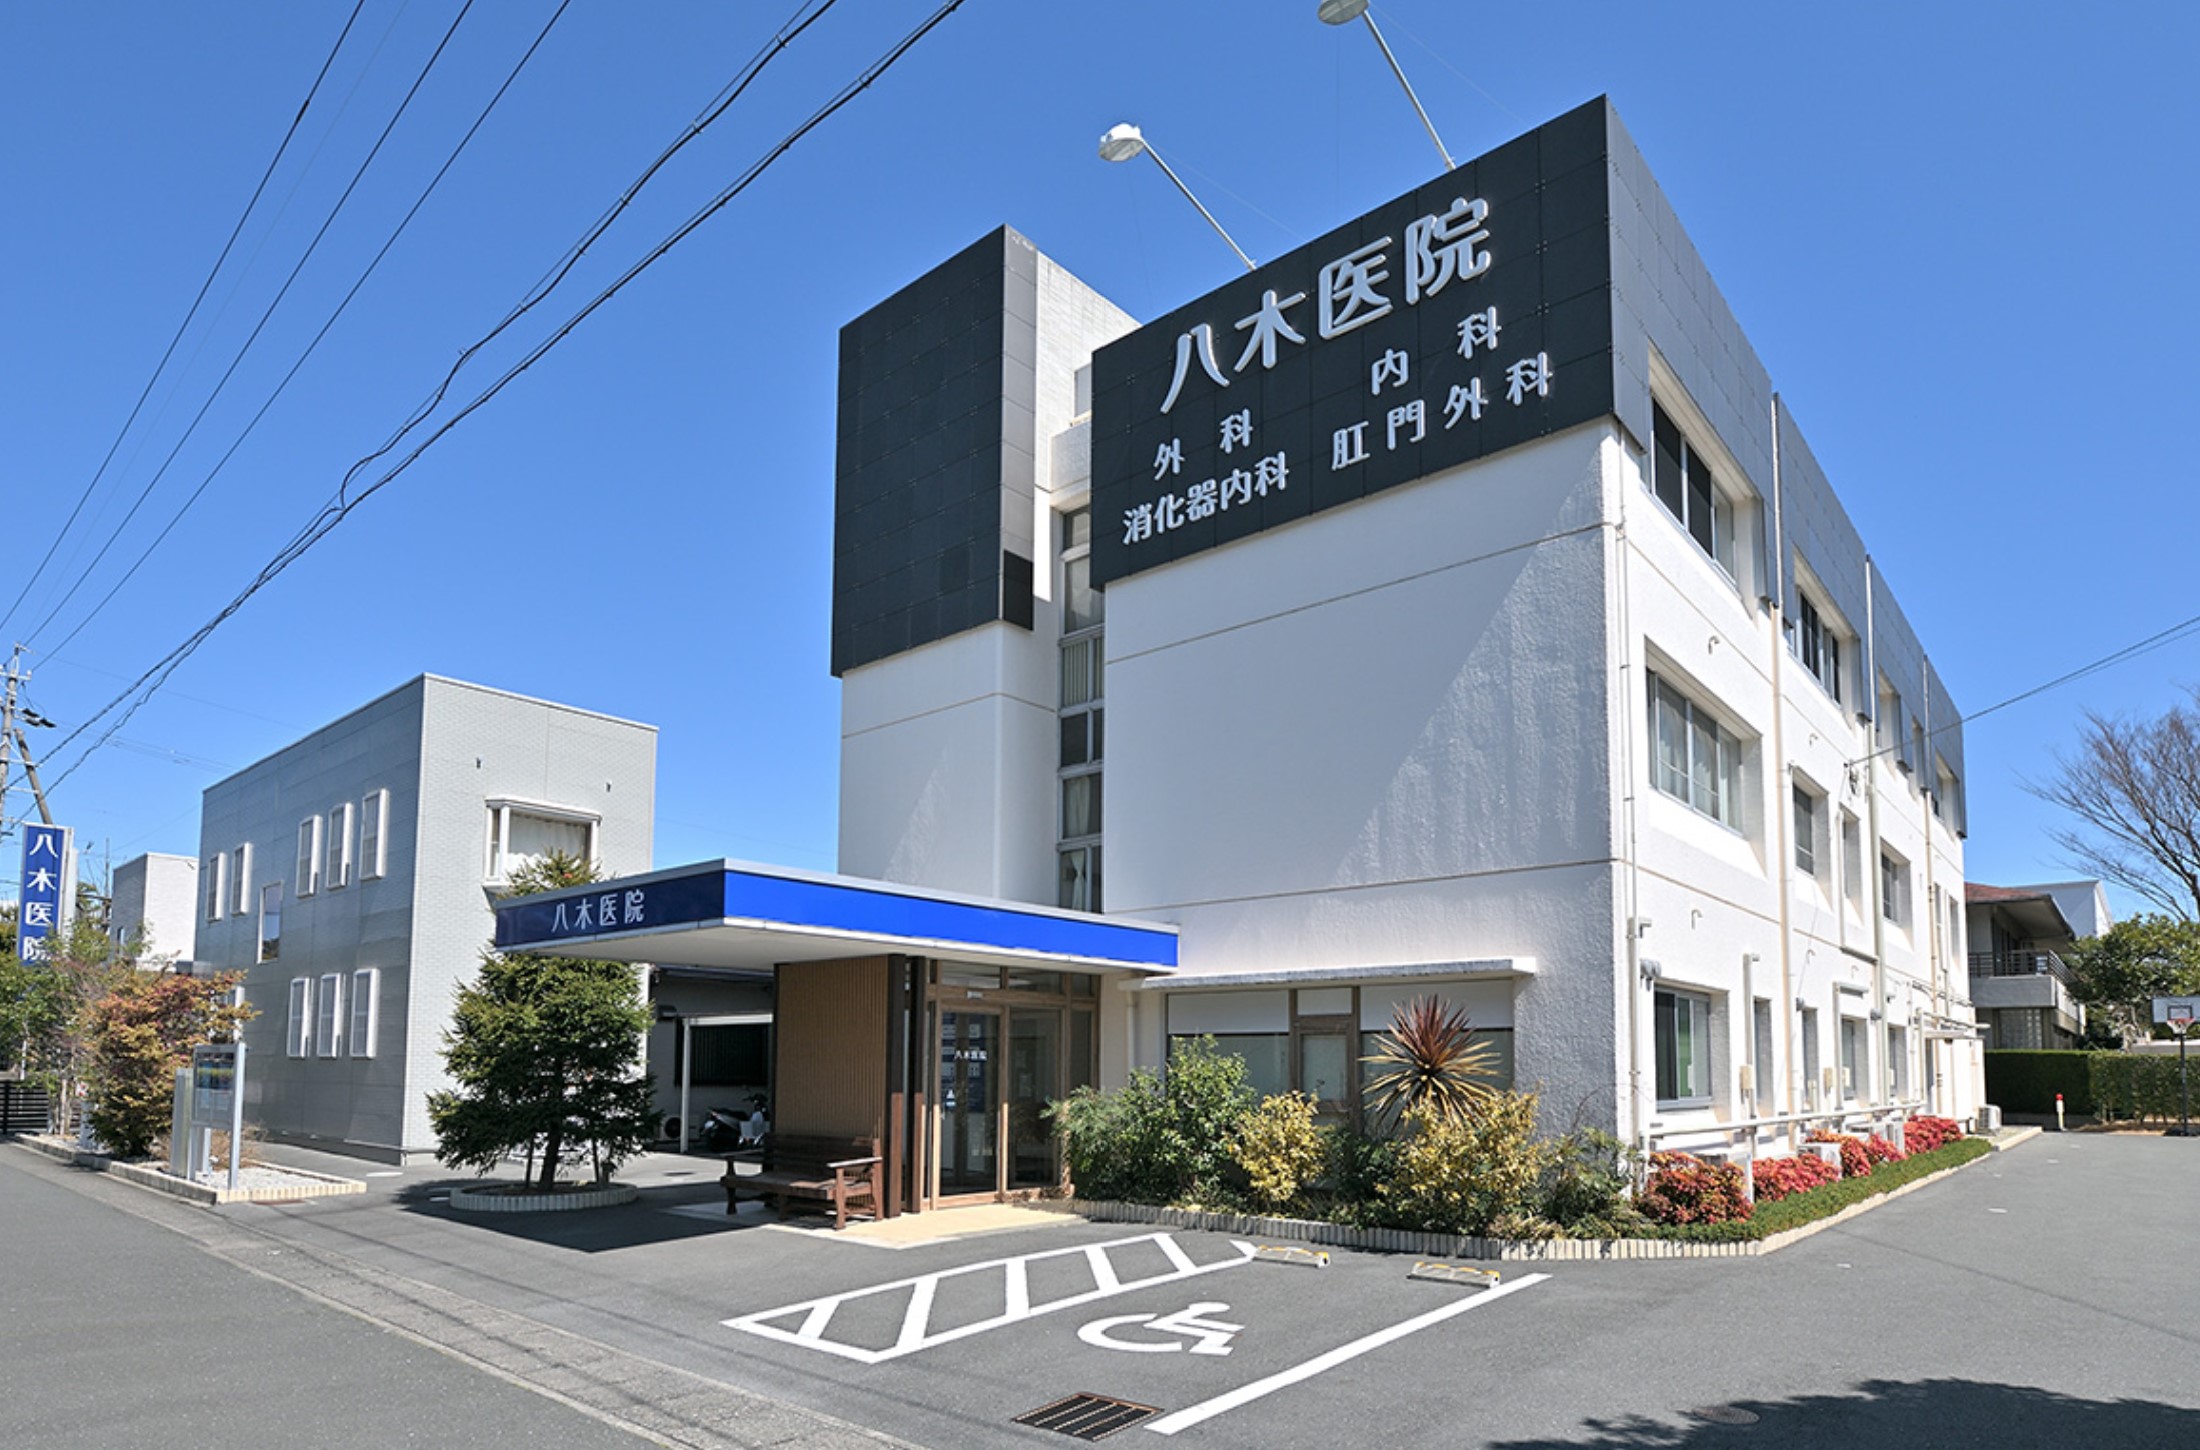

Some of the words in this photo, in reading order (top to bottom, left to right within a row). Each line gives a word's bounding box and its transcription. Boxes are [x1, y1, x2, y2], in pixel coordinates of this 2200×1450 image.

[1160, 197, 1492, 414] 八木医院
[1122, 451, 1290, 545] 消化器内科
[1331, 351, 1553, 471] 肛門外科
[552, 889, 645, 932] 八木医院
